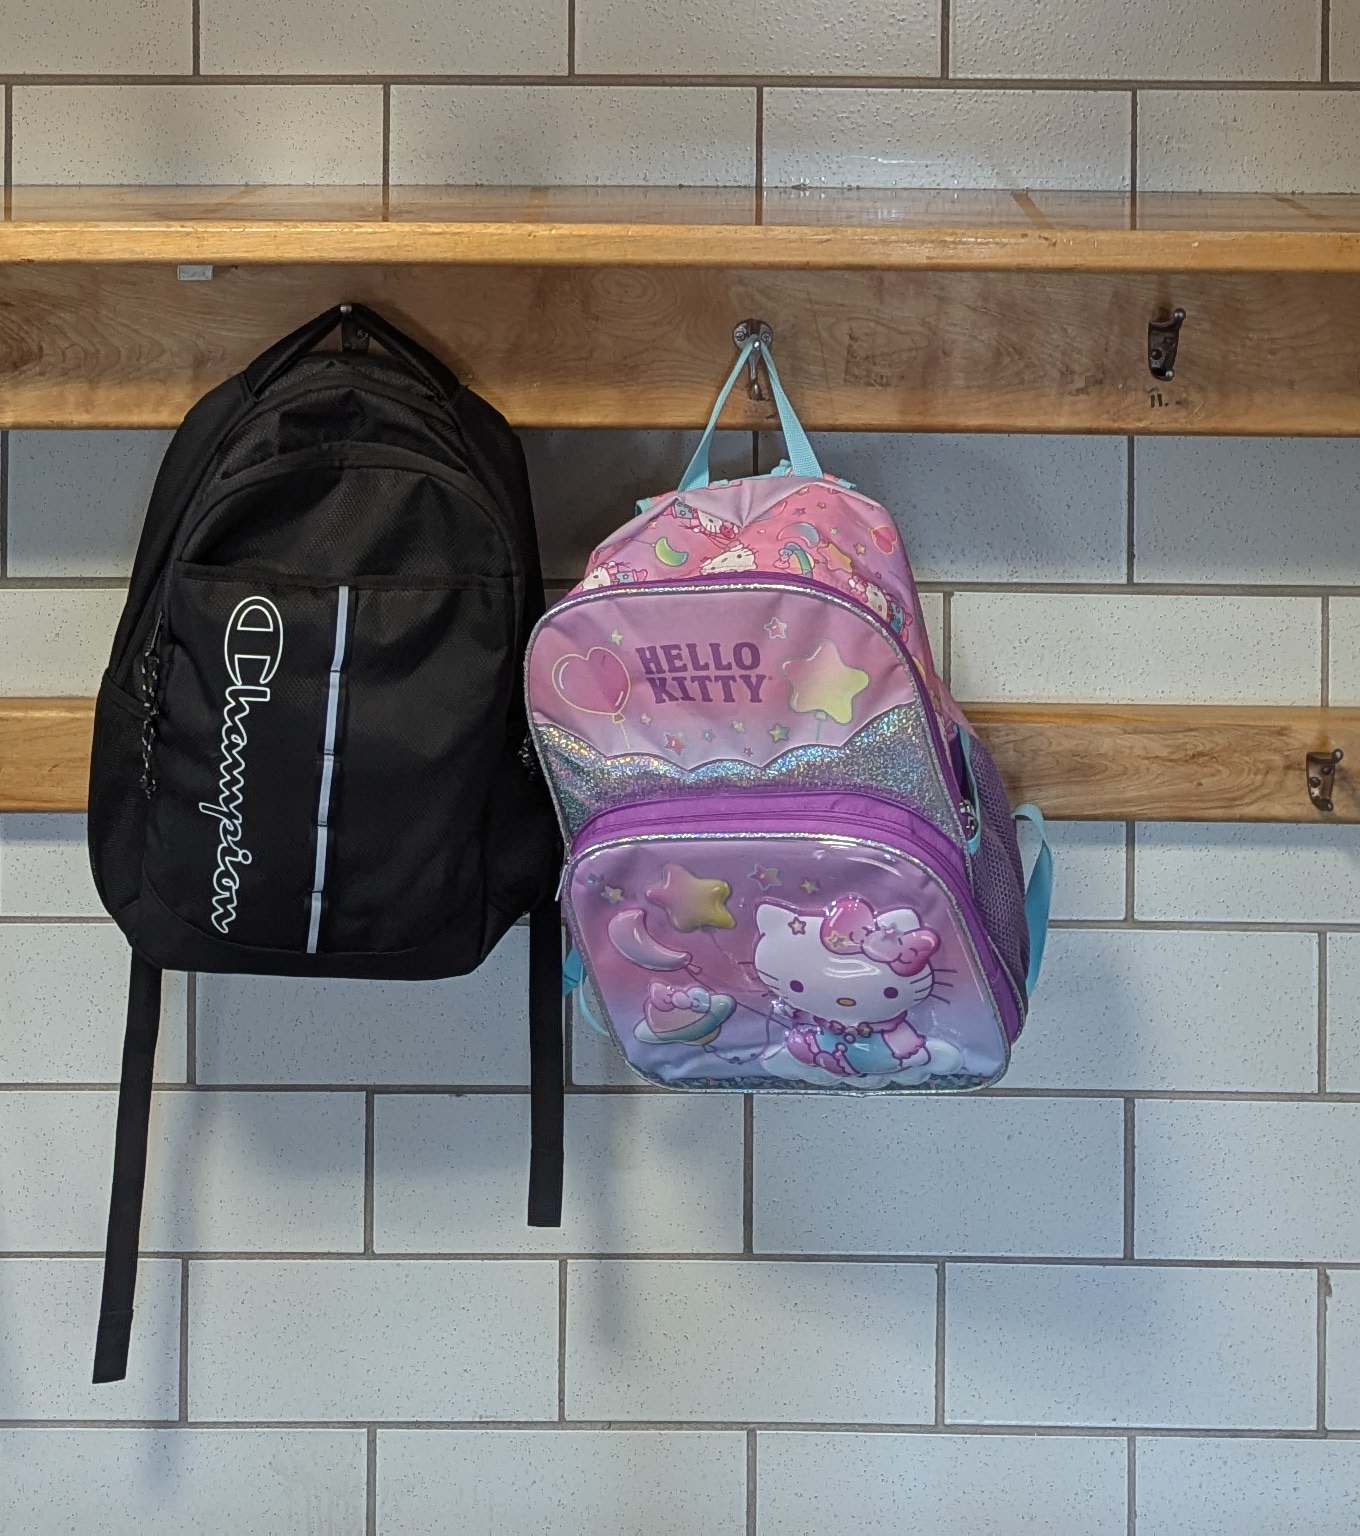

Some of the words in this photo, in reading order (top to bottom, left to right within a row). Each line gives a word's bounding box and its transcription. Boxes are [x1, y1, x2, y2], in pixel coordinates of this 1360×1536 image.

[635, 642, 761, 674] HELLO
[646, 674, 766, 704] KITTY
[198, 595, 284, 934] Champion
